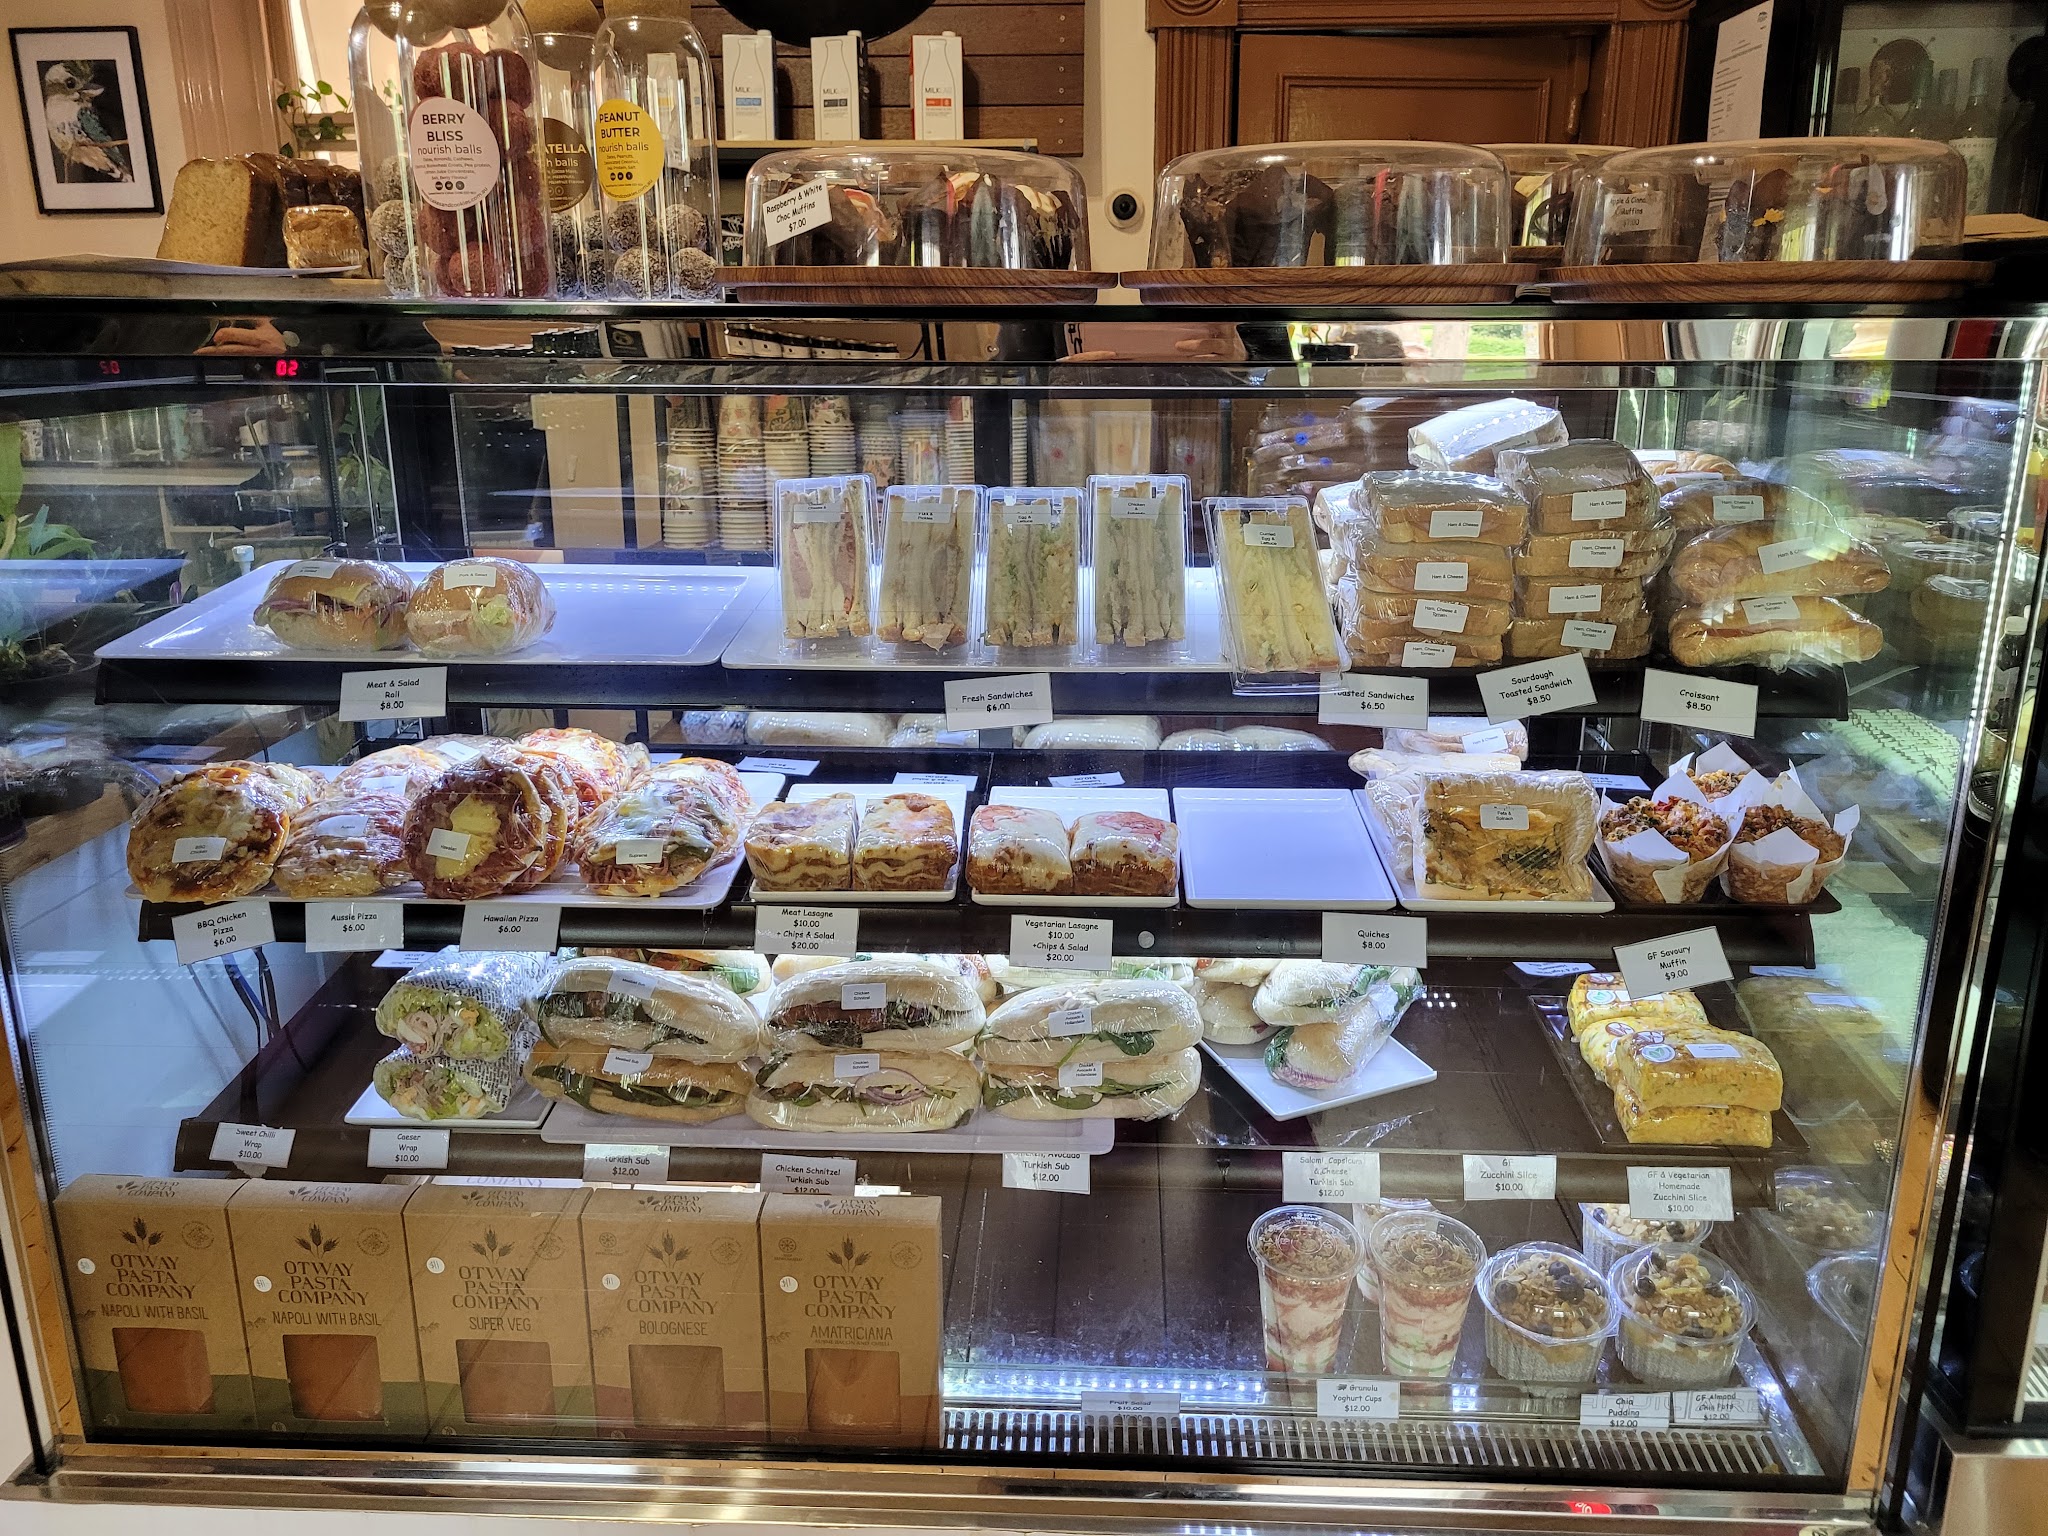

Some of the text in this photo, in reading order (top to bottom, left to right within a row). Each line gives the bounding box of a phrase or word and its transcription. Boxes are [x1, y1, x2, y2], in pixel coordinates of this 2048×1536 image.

[422, 113, 465, 124] BERRY
[599, 112, 640, 123] PEANUT
[427, 131, 463, 141] BLISS
[601, 128, 640, 138] BUTTER
[418, 144, 482, 155] nourish balls
[599, 142, 649, 153] nourish balls
[766, 184, 823, 214] Raspberry & White
[776, 201, 816, 224] Choc Muffins
[788, 217, 807, 233] $7.00
[276, 359, 299, 376] 02
[1511, 670, 1555, 686] Sourdough
[366, 679, 420, 689] Meat & Salad
[1499, 677, 1573, 700] Toasted Sandwich
[385, 691, 400, 699] Roll
[962, 690, 1033, 703] Fresh Sandwiches
[1527, 693, 1551, 706] $8.50
[1679, 689, 1720, 702] Croissant
[380, 701, 404, 711] $8.00
[1361, 701, 1385, 711] $6.50
[1685, 700, 1712, 712] $8.50
[483, 914, 539, 923] Hawaiian Pizza
[781, 908, 834, 919] Meat Lasagne
[197, 911, 247, 930] BBQ Chicken
[793, 919, 820, 928] $10.00
[1025, 919, 1099, 932] Vegetarian Lasagne
[213, 926, 234, 936] Pizza
[342, 923, 366, 933] $6.00
[498, 925, 521, 934] $6.00
[783, 930, 804, 939] Chips
[806, 931, 811, 939] &
[813, 931, 835, 940] Salad
[1048, 931, 1075, 940] $10.00
[1357, 929, 1390, 939] Quiches
[213, 935, 237, 947] $6.00
[791, 941, 819, 950] $20.00
[1362, 940, 1386, 950] $8.00
[1060, 943, 1065, 951] &
[1067, 943, 1089, 952] Salad
[1046, 953, 1075, 962] $20.00
[1647, 946, 1691, 961] GF Savoury
[1660, 958, 1687, 970] Muffin
[1664, 969, 1689, 981] $9.00
[236, 1128, 276, 1139] Sweet Chilli
[396, 1133, 421, 1141] Caeser
[244, 1140, 262, 1149] Wrap
[398, 1143, 418, 1153] Wrap
[238, 1150, 262, 1159] $10.00
[395, 1154, 419, 1163] $10.00
[612, 1166, 640, 1176] $12.00
[775, 1164, 841, 1176] Chicken Schnitzel
[1022, 1160, 1070, 1171] Turkish Sub
[1314, 1167, 1348, 1175] & Cheese
[1033, 1173, 1060, 1182] $12.00
[1480, 1170, 1538, 1179] Zucchini Slice
[1647, 1170, 1710, 1181] GF & Vegetarian
[466, 1175, 544, 1187] COMPANY
[785, 1175, 830, 1186] Turkish Sub
[1309, 1178, 1337, 1186] Turkish
[1658, 1182, 1701, 1190] Homemade
[1318, 1189, 1345, 1197] $12.00
[1495, 1183, 1523, 1192] $10.00
[1653, 1193, 1707, 1202] Zucchini Slice
[1667, 1204, 1695, 1213] $10.00
[110, 1253, 179, 1270] OTWAY
[284, 1260, 354, 1276] OTWAY
[117, 1268, 178, 1285] PASTA
[459, 1266, 528, 1282] OTWAY
[634, 1270, 705, 1286] OTWAY
[290, 1275, 352, 1291] PASTA
[464, 1280, 527, 1296] PASTA
[813, 1275, 884, 1291] OTWAY
[106, 1282, 196, 1300] COMPANY
[640, 1285, 701, 1300] PASTA
[278, 1289, 369, 1306] COMPANY
[818, 1289, 880, 1305] PASTA
[452, 1295, 543, 1311] COMPANY
[627, 1298, 718, 1315] COMPANY
[101, 1303, 209, 1320] NAPOLI WITH BASIL
[804, 1303, 897, 1320] COMPANY
[272, 1311, 382, 1326] NAPOLI WITH BASIL
[470, 1317, 532, 1332] SUPER VEG
[639, 1320, 709, 1336] BOLOGNESE
[810, 1325, 893, 1340] AMATRICIANA
[1332, 1394, 1382, 1404] Yoghurt Cups
[1344, 1404, 1371, 1413] $12.00
[1608, 1408, 1640, 1417] Pudding
[1703, 1413, 1730, 1421] $12.00
[1609, 1419, 1638, 1428] $12.00
